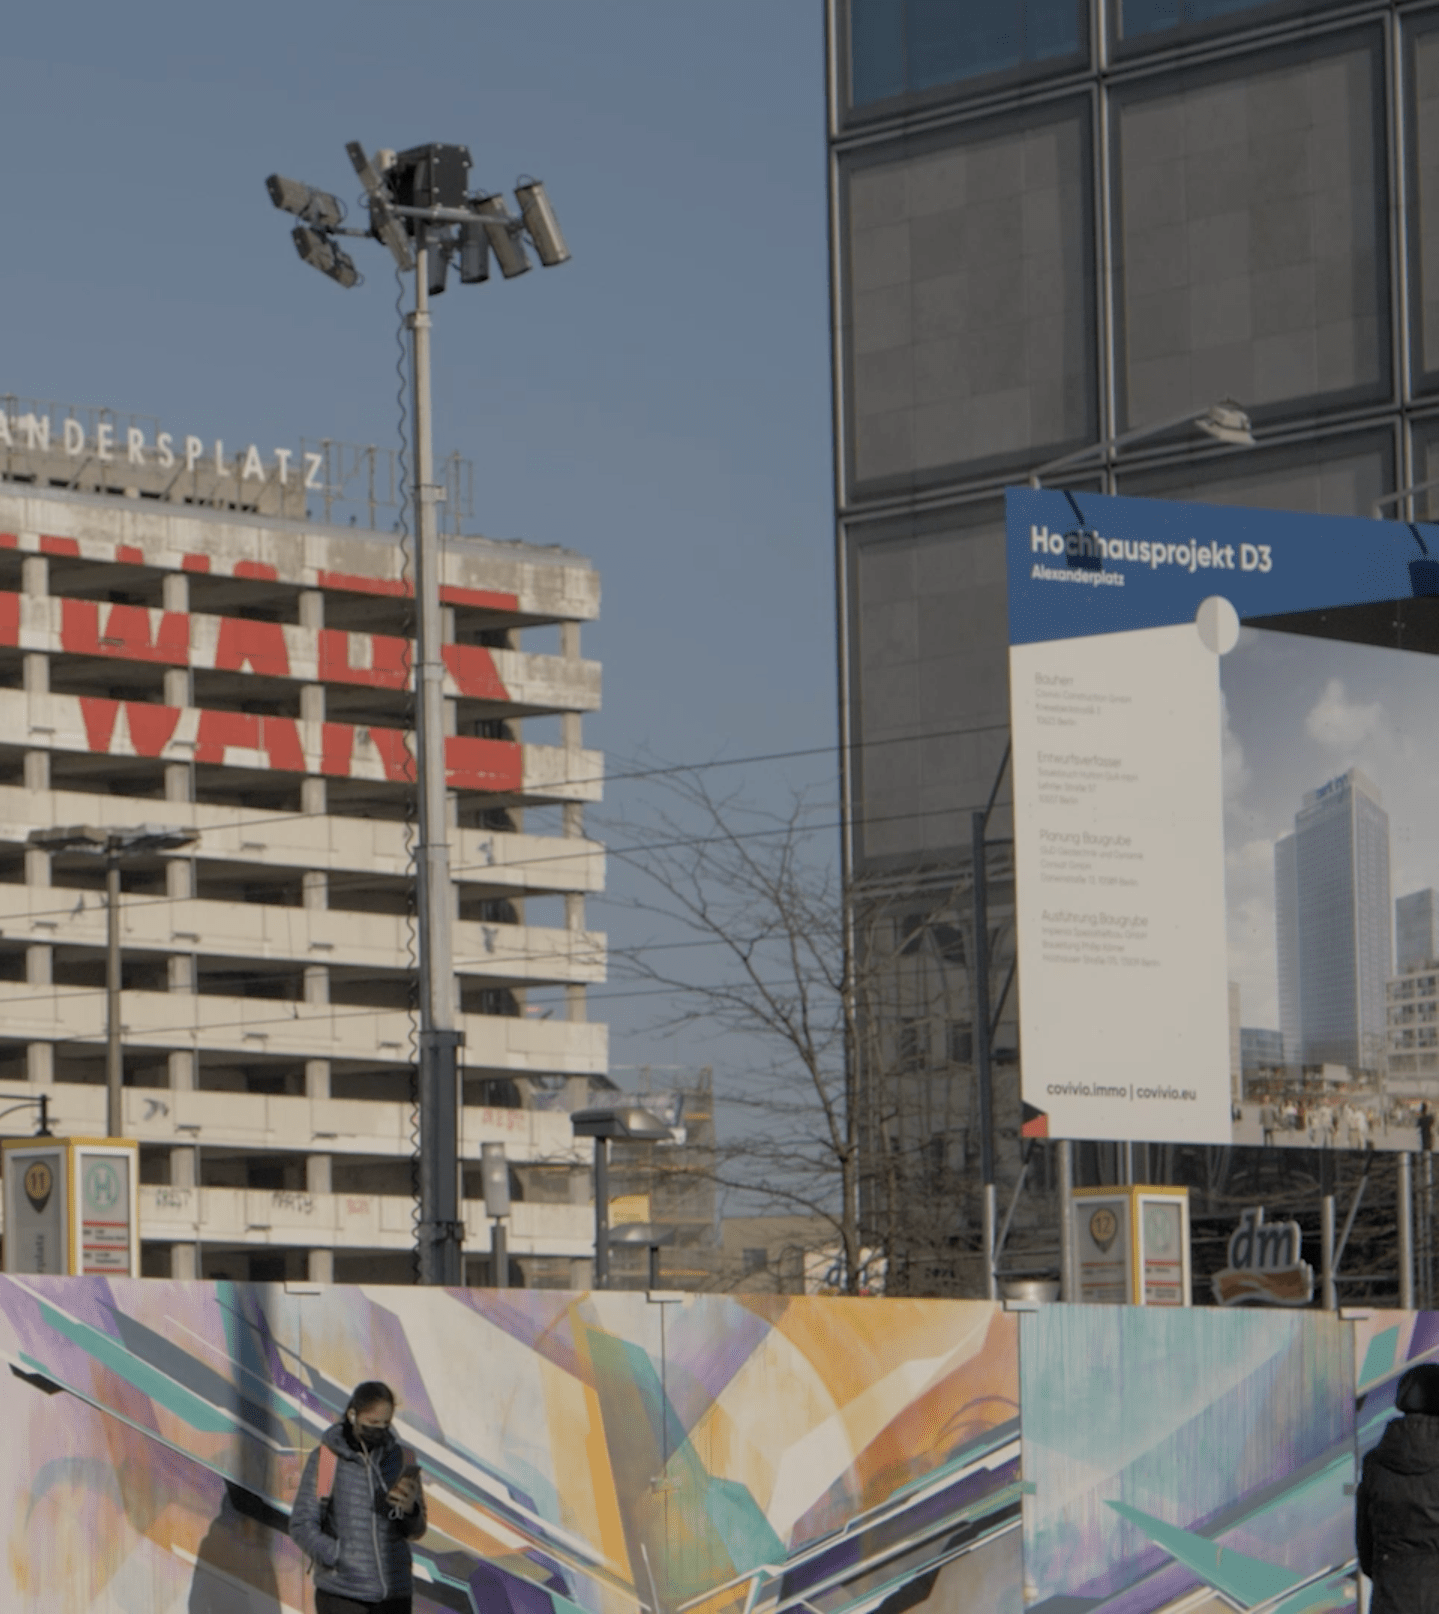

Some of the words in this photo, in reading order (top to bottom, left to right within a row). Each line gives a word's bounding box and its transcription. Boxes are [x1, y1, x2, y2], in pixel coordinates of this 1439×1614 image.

[1030, 525, 1236, 574] Hochhausprojekt
[1240, 542, 1273, 573] D3
[1031, 563, 1126, 587] Alexanderplatz
[1039, 828, 1080, 846] Planung
[1082, 830, 1132, 848] Baugrube
[1041, 909, 1098, 927] Ausführung
[1099, 911, 1149, 928] Baugrube
[1046, 1081, 1127, 1099] covivio.immo
[1136, 1084, 1197, 1101] covivio.eu
[1094, 1216, 1111, 1235] 12
[1230, 1210, 1296, 1269] dm
